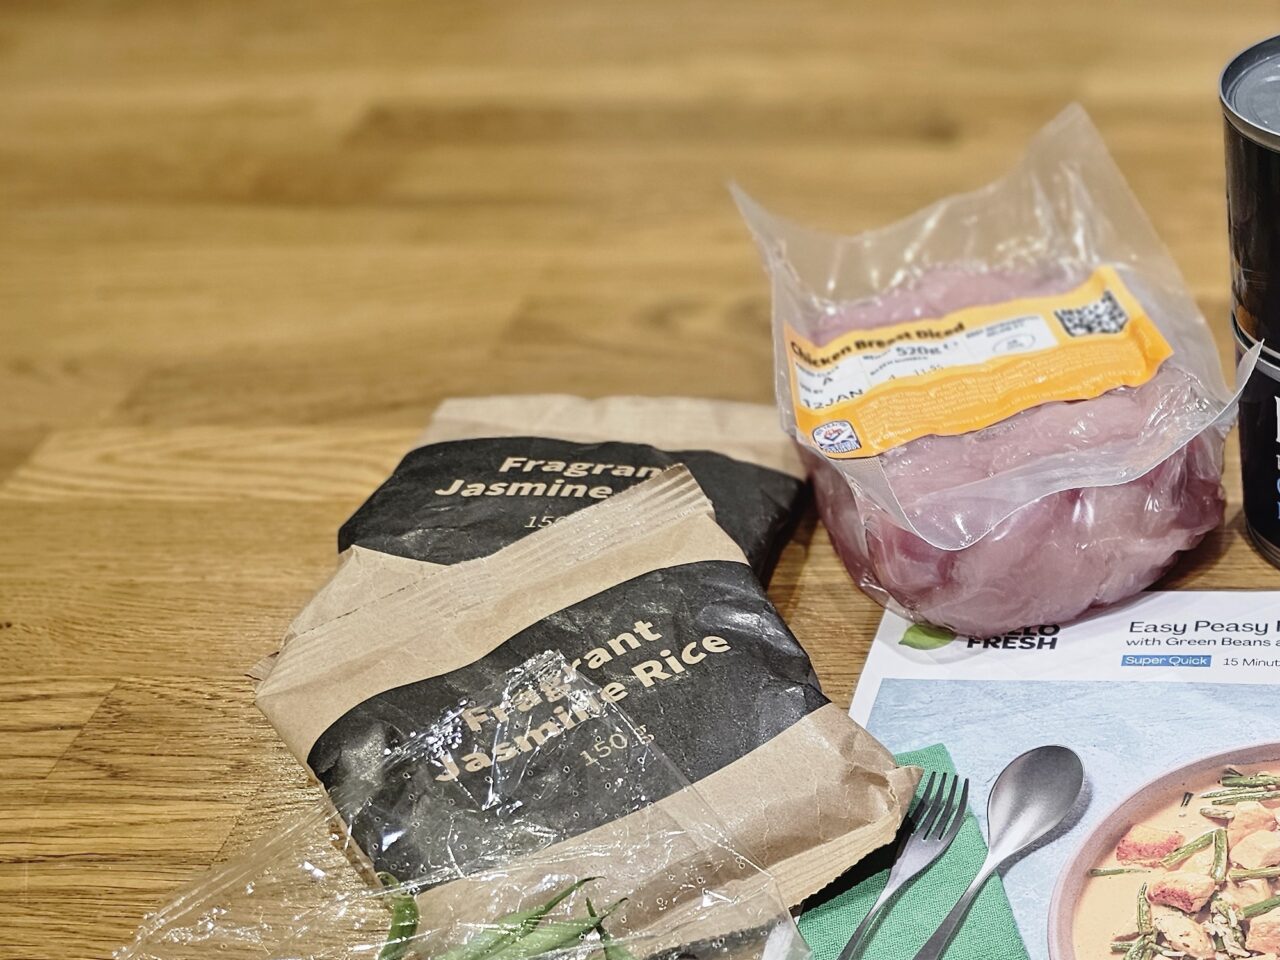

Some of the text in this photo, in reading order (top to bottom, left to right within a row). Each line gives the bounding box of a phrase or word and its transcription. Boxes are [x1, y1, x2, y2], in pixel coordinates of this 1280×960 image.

[790, 340, 852, 368] Chicken
[854, 332, 912, 350] Breast
[916, 321, 966, 340] Diced
[434, 479, 614, 500] Jasmine
[1129, 621, 1188, 636] Easy
[1194, 620, 1269, 636] Peasy
[967, 635, 1059, 650] FRESH
[1126, 637, 1161, 647] with
[1165, 637, 1217, 647] Green
[1221, 637, 1271, 648] Beans
[630, 634, 732, 689] Rice
[1125, 656, 1208, 667] Super Quick
[1223, 658, 1239, 667] 15
[579, 733, 628, 768] 150
